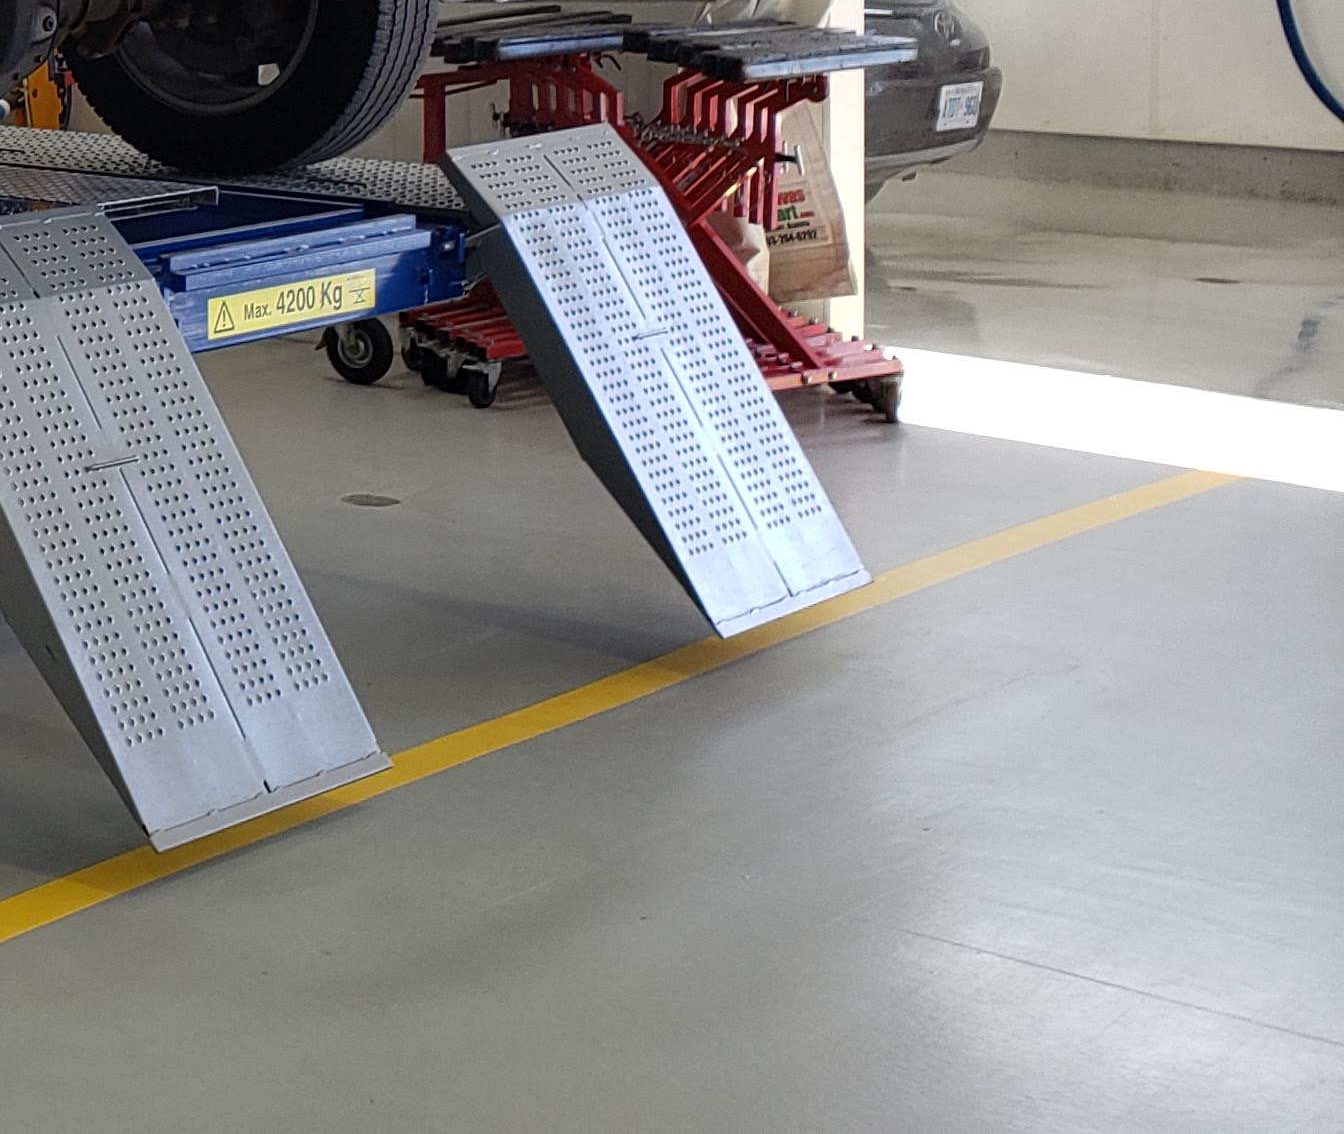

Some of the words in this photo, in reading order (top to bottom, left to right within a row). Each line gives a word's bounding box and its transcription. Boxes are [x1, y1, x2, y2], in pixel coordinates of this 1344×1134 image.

[243, 302, 272, 322] Max.
[276, 285, 316, 315] 4200
[320, 280, 343, 311] Kg
